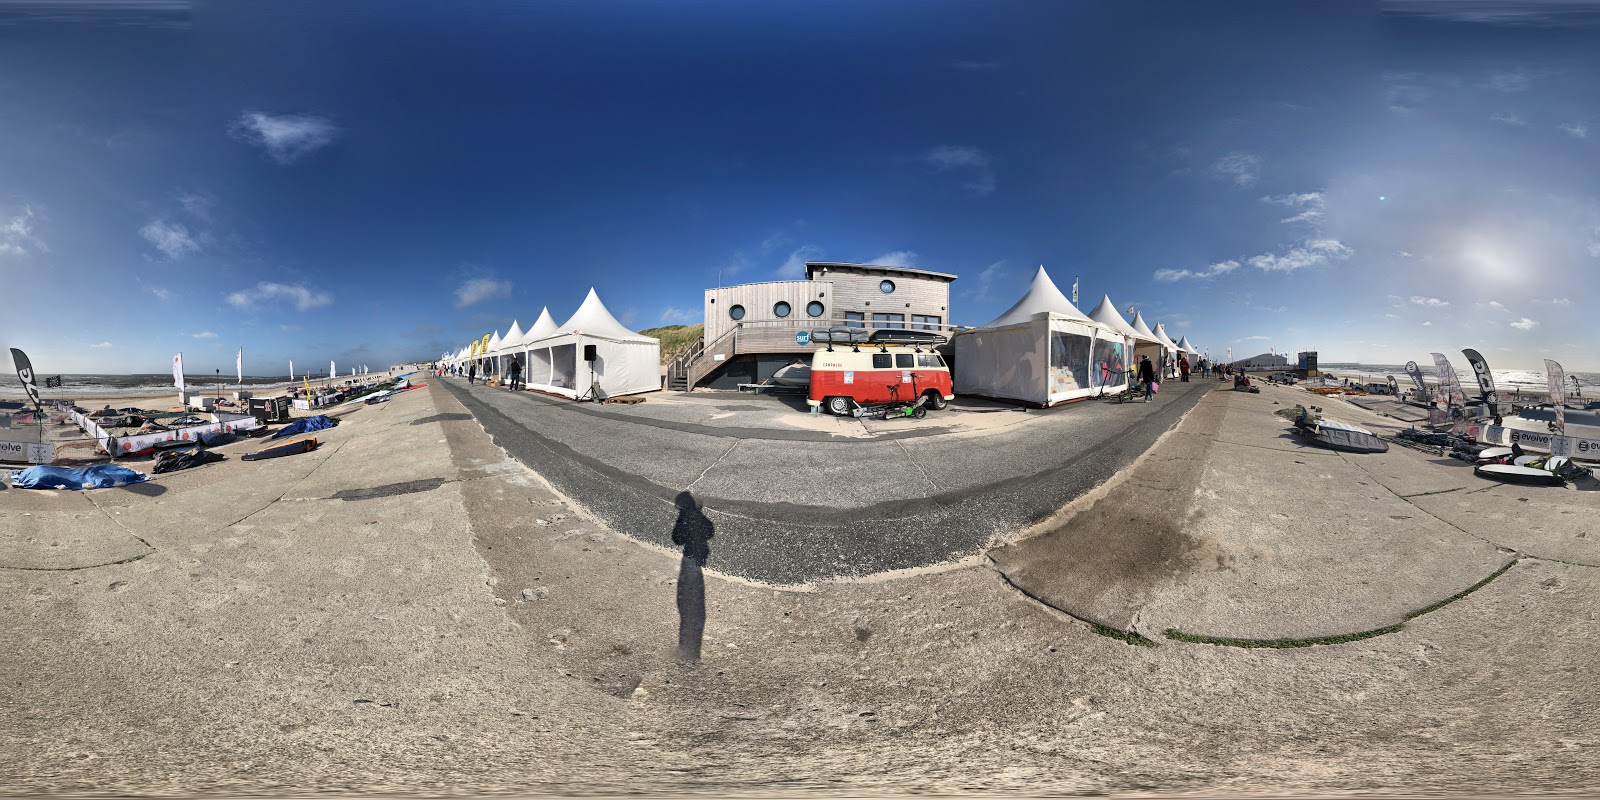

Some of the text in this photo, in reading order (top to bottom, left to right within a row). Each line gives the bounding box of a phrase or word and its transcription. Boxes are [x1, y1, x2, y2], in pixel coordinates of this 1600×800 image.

[796, 334, 810, 342] surf
[1521, 433, 1549, 443] evolve
[0, 443, 21, 452] olve
